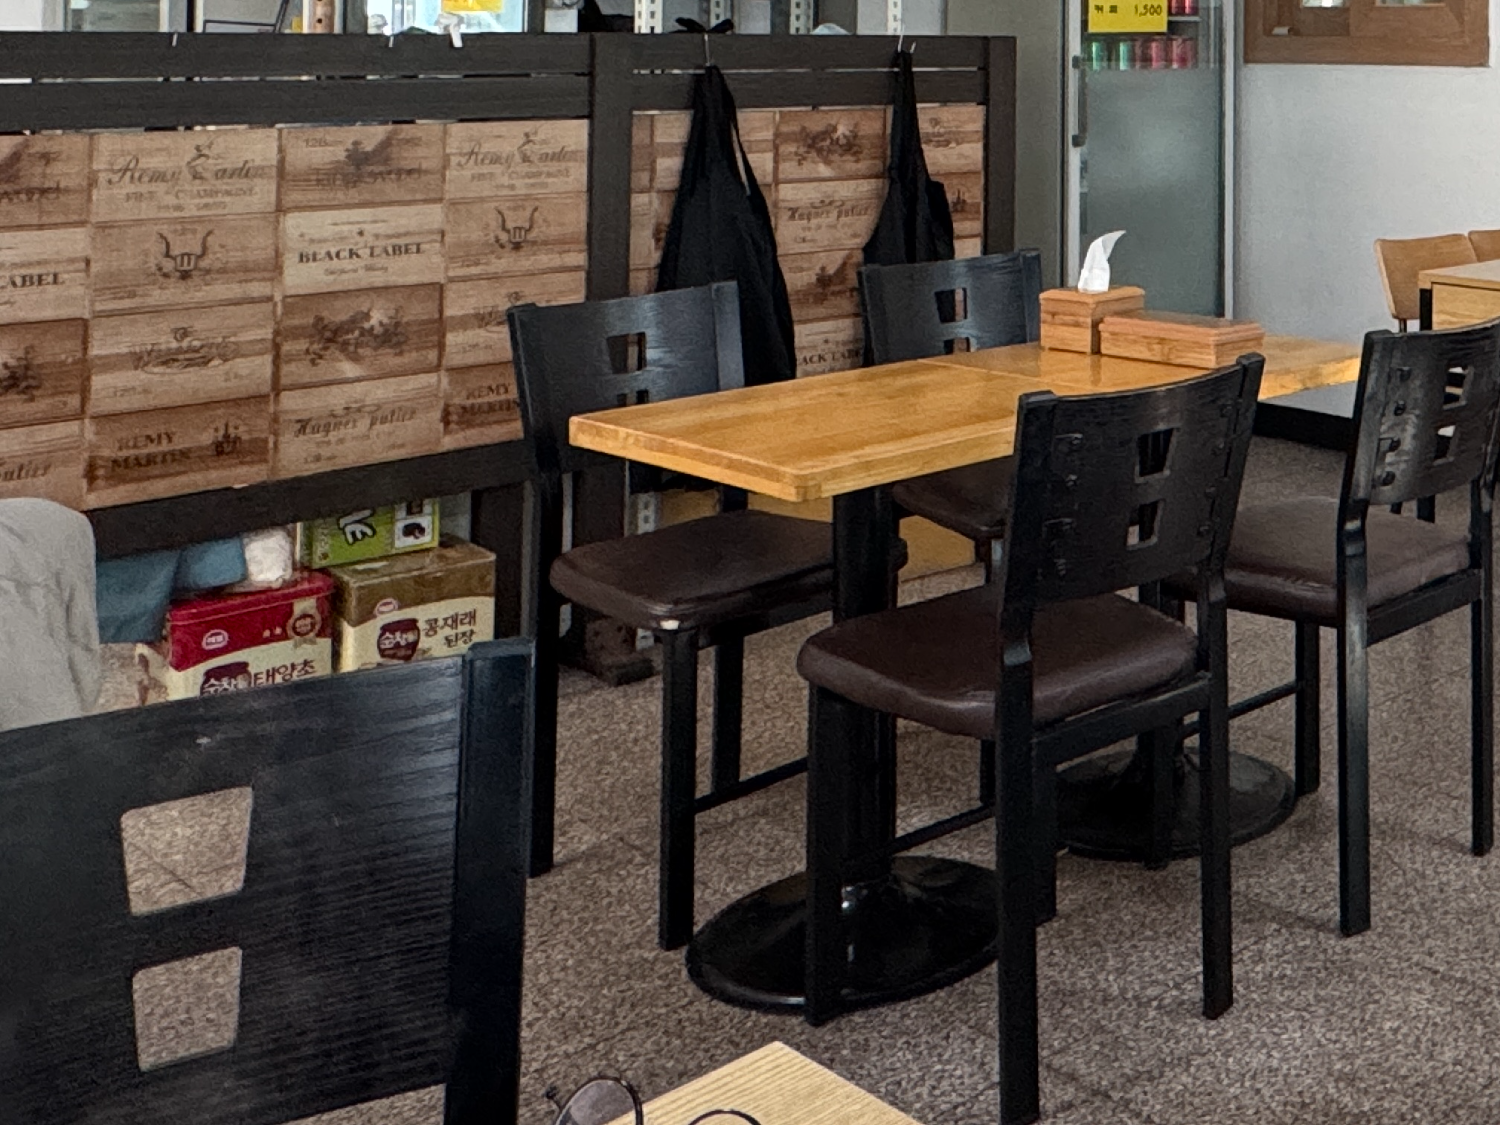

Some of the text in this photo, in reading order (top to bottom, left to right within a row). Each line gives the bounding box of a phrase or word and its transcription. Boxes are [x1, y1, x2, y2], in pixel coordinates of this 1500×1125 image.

[1134, 3, 1163, 17] 1,500
[298, 242, 424, 264] BLACK LABEL
